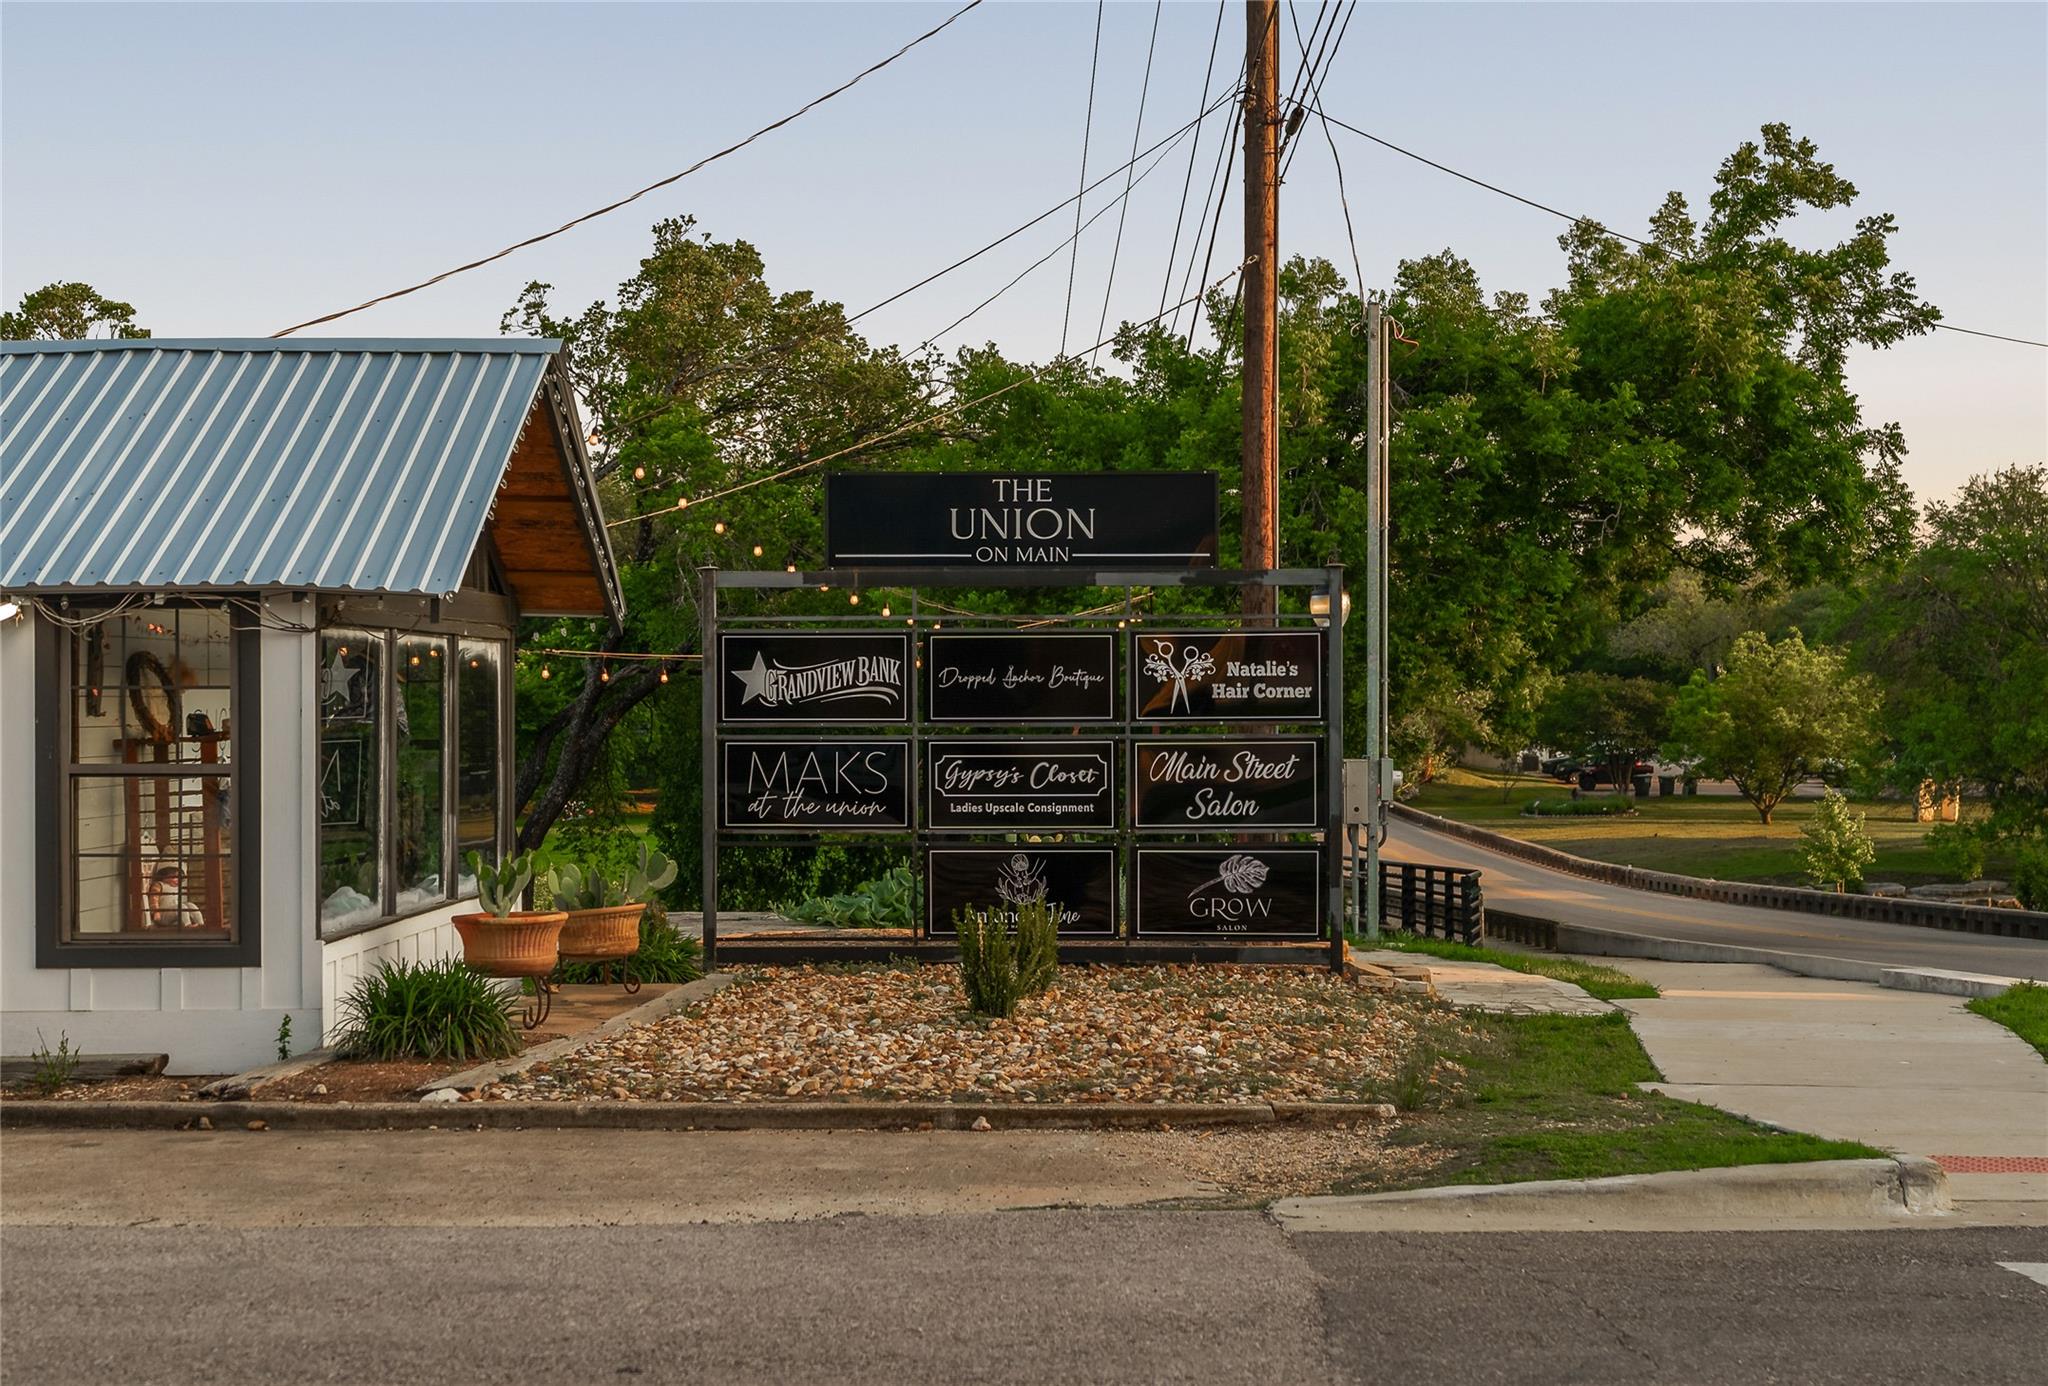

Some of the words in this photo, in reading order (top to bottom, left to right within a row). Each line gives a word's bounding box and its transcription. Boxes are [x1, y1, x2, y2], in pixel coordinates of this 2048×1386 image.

[991, 478, 1053, 502] THE
[950, 507, 1096, 540] UNION
[975, 546, 1008, 562] ON
[1016, 546, 1069, 562] MAIN
[763, 659, 857, 705] GRANDVIEW
[855, 656, 902, 687] BANK
[938, 667, 997, 689] Dropped
[1002, 665, 1045, 689] Anchor
[1048, 665, 1105, 690] Boutique
[1226, 660, 1299, 677] Natalie's
[1211, 683, 1250, 699] Hair
[1253, 683, 1313, 699] Corner
[747, 751, 888, 795] MAKS
[944, 759, 1025, 791] Gypsy's
[1029, 761, 1100, 790] Closet
[1149, 751, 1221, 783] Main
[1223, 750, 1300, 783] Street
[747, 790, 778, 819] at
[782, 787, 821, 819] the
[825, 801, 888, 817] union
[950, 802, 983, 813] Ladies
[985, 802, 1025, 815] Upscale
[1027, 802, 1095, 815] Consignment
[1186, 787, 1260, 820] Salon
[1189, 897, 1272, 921] GROW
